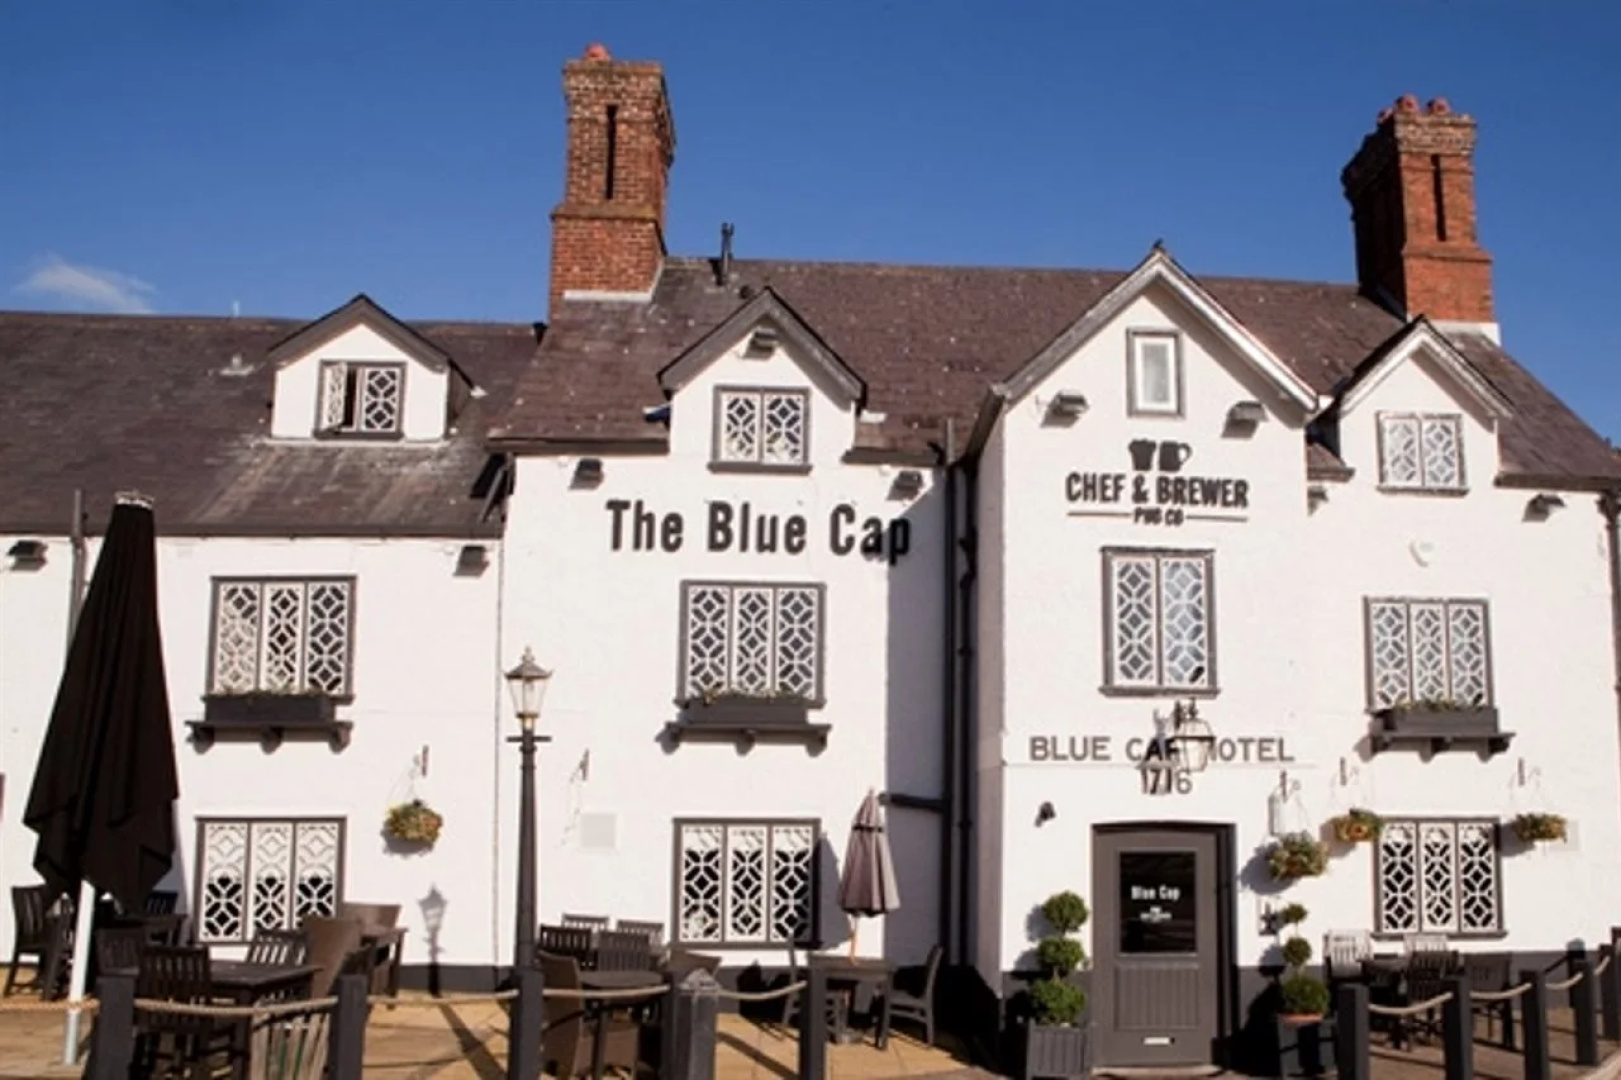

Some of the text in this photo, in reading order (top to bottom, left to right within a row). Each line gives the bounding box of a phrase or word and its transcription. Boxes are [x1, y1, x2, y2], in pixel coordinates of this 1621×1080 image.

[1066, 472, 1249, 508] CHEF & BREWER
[605, 499, 912, 566] The Blue Cap
[1029, 736, 1111, 761] BLUE
[1140, 768, 1193, 795] 1716
